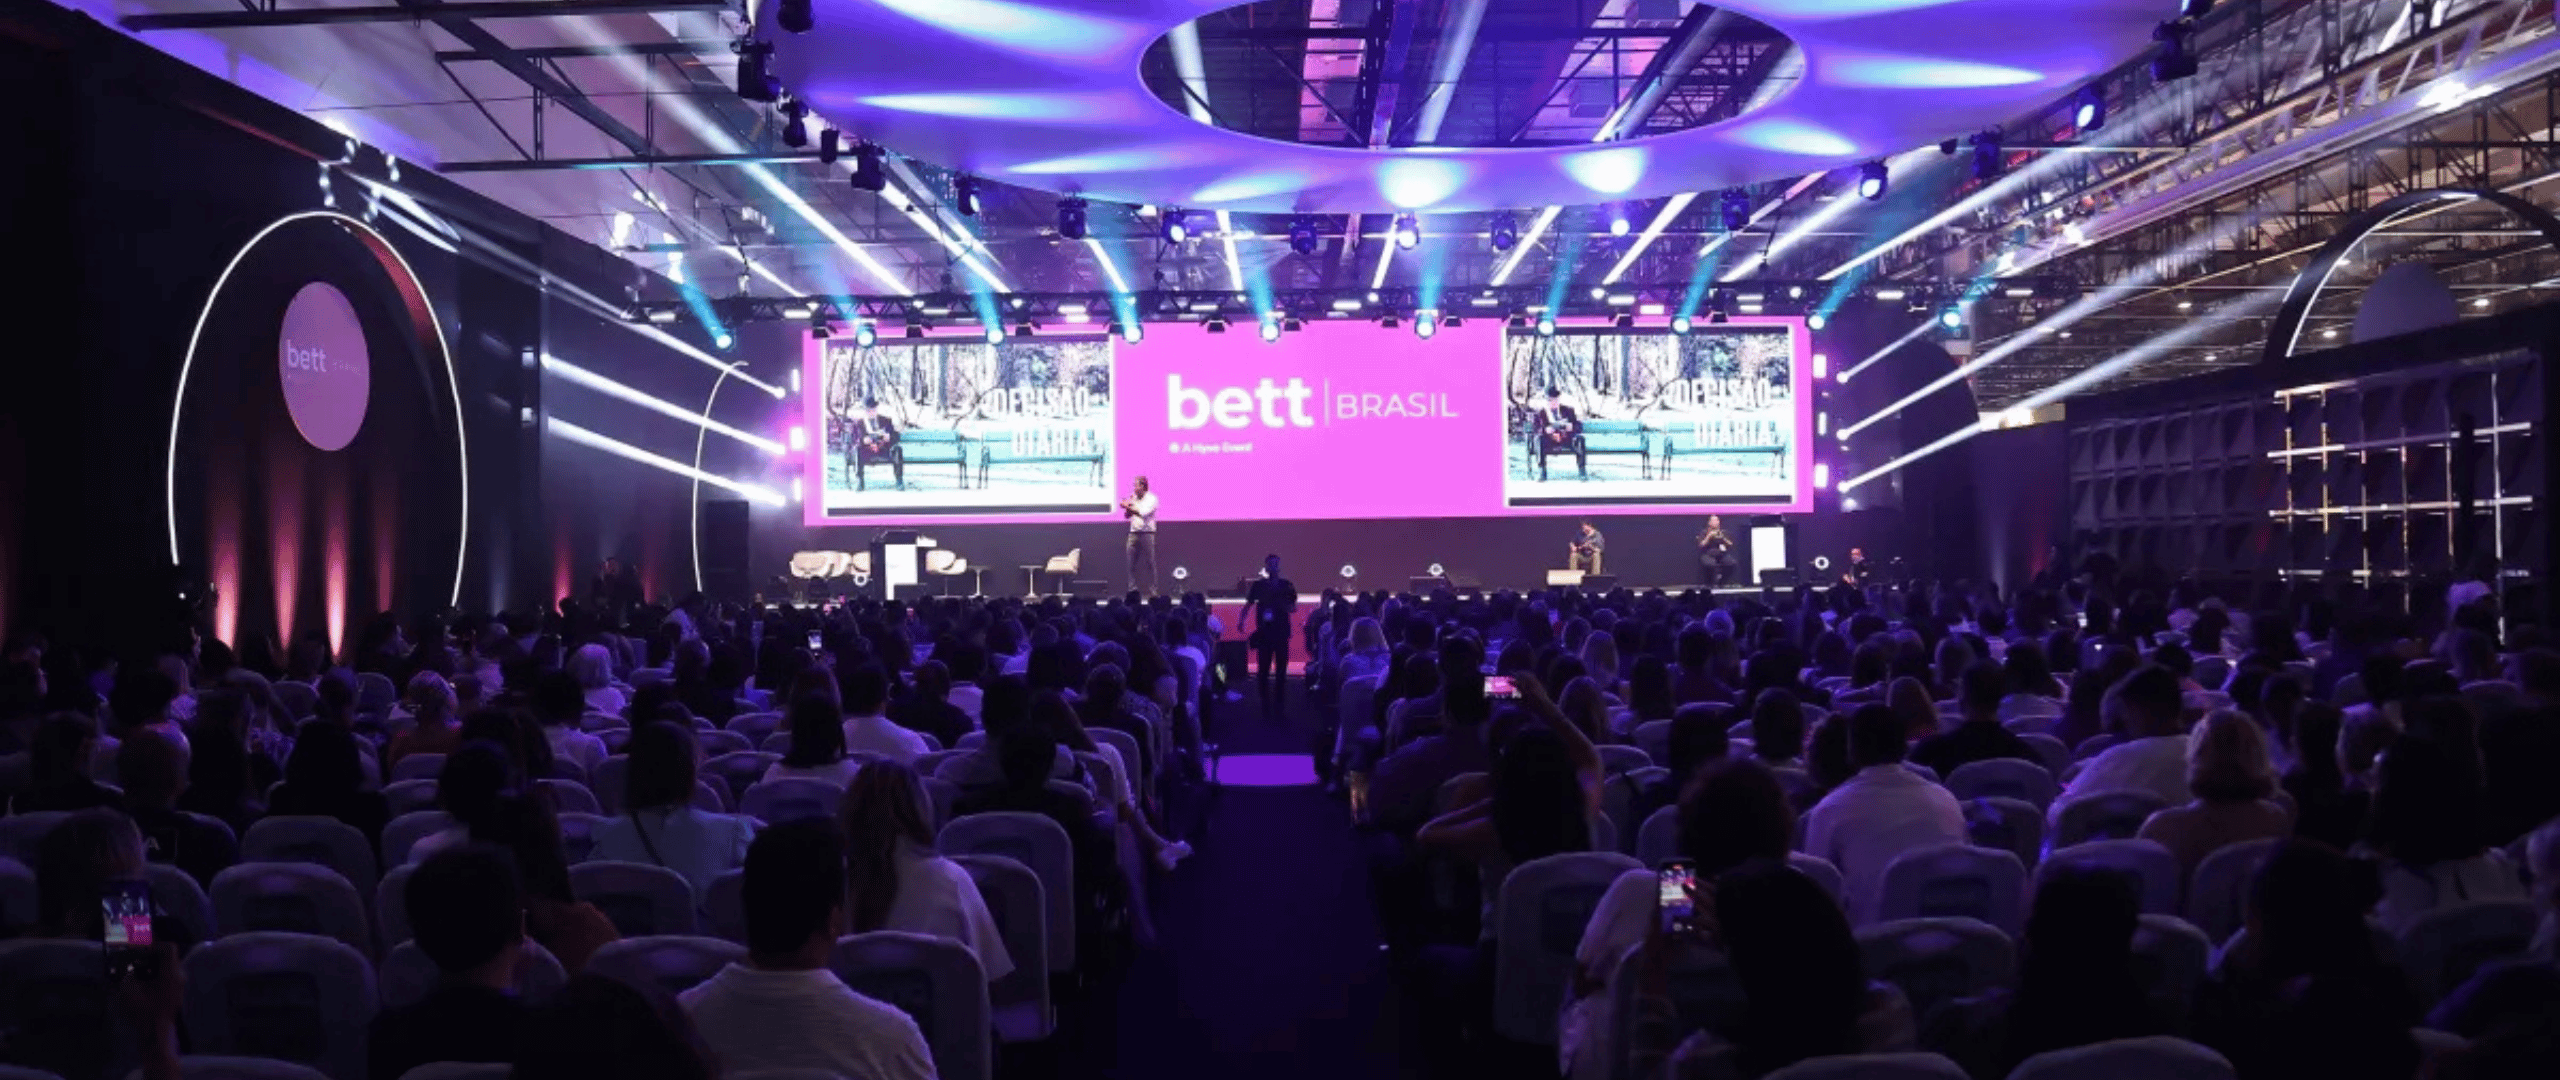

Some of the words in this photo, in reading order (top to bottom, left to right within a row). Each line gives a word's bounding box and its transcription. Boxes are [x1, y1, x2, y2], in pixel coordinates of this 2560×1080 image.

[286, 339, 327, 373] bett
[1168, 373, 1314, 429] bett
[1336, 392, 1459, 419] BRASIL
